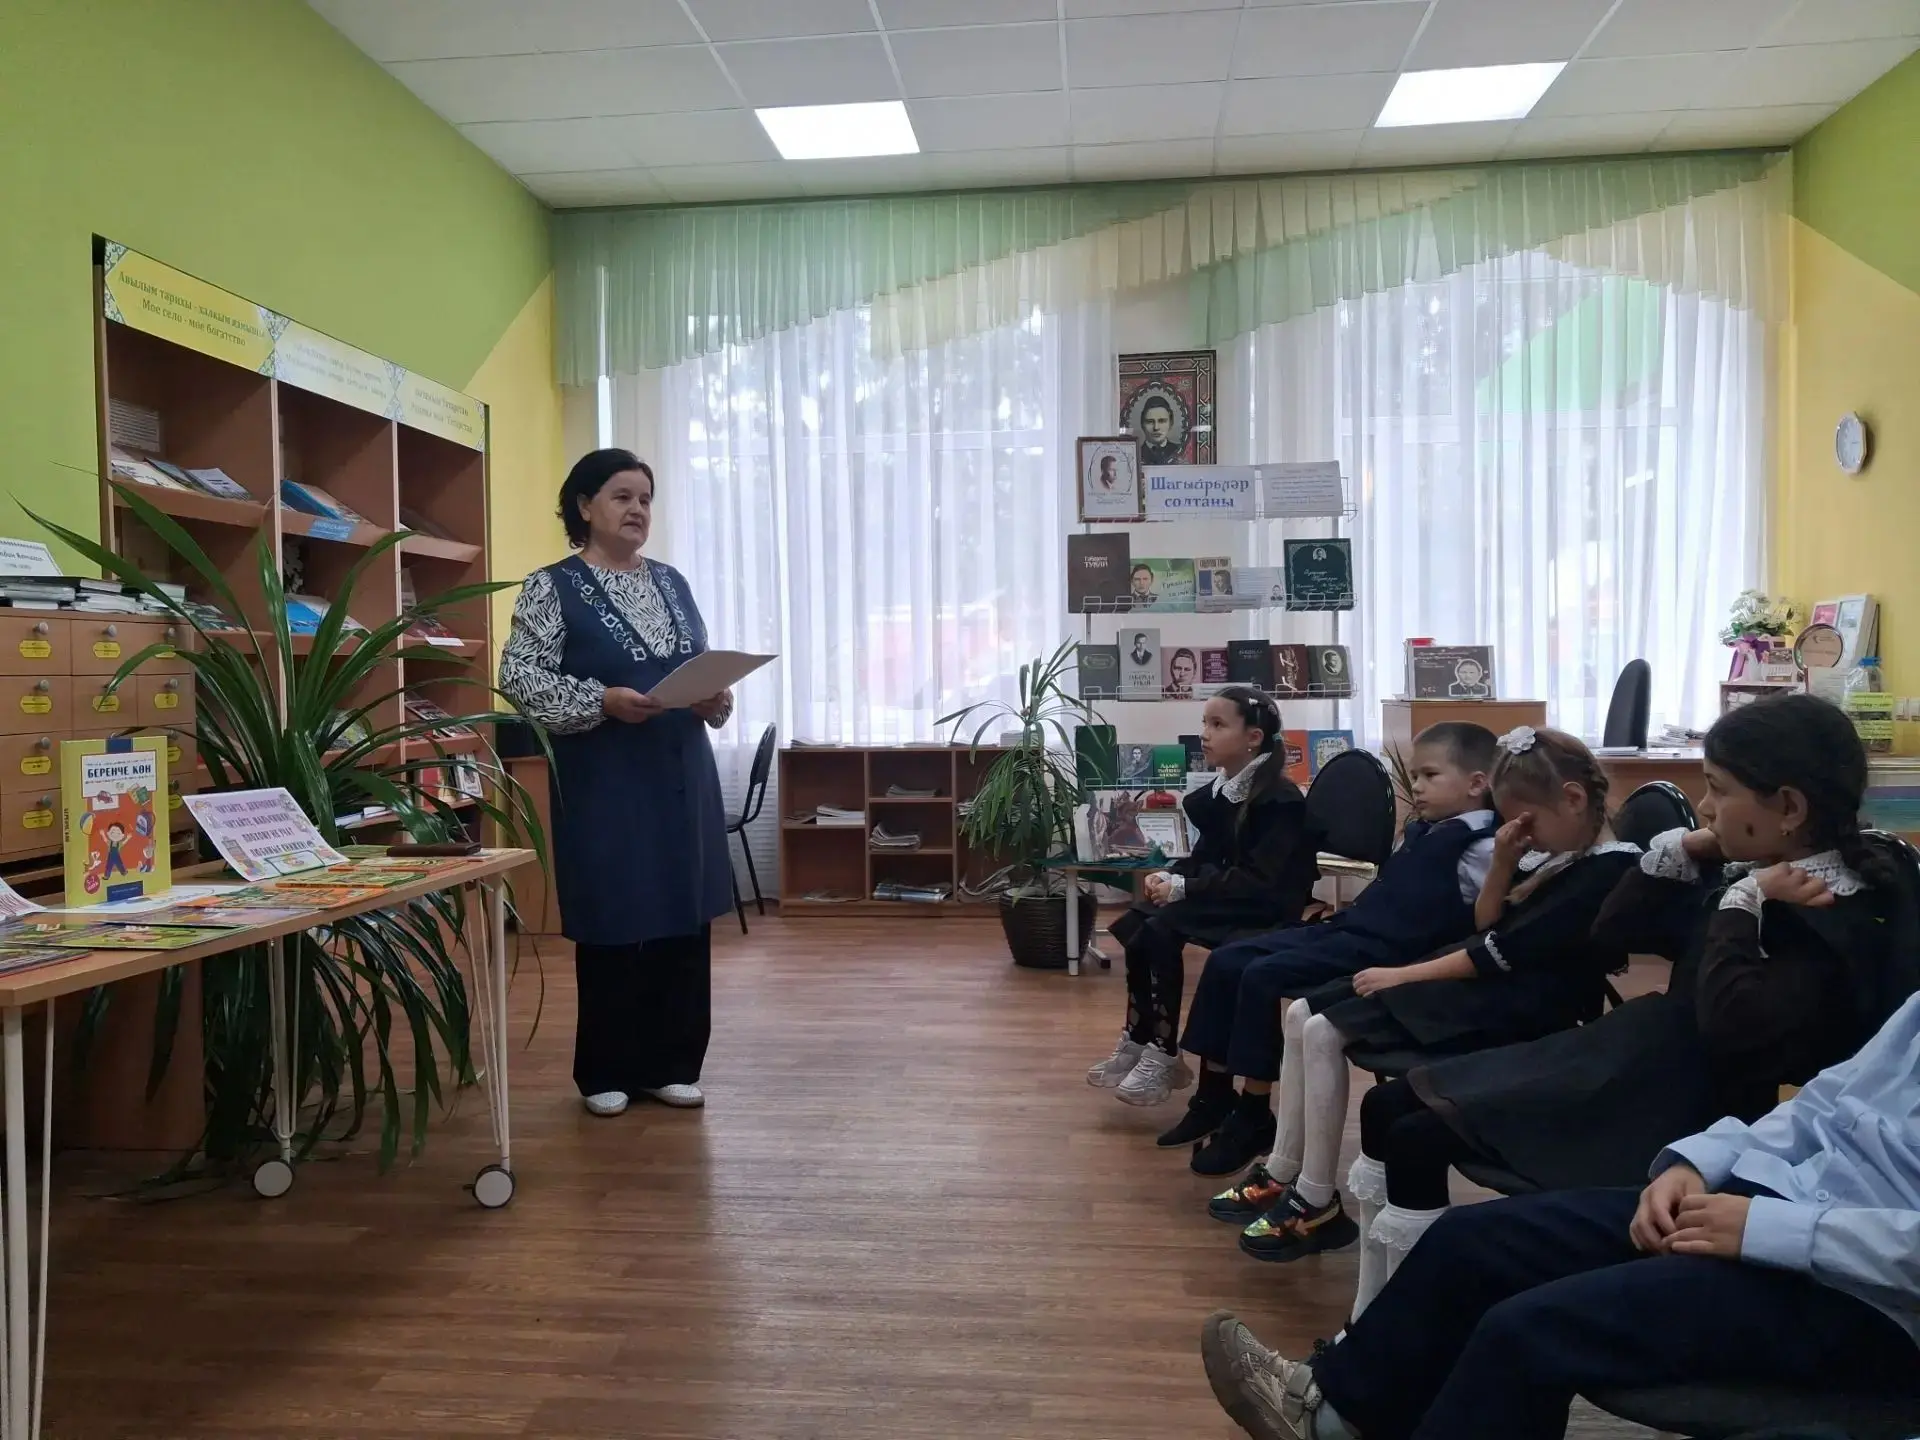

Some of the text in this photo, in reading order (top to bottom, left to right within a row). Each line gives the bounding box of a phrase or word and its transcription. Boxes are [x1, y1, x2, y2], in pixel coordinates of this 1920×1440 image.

[118, 271, 158, 297] Авылым
[159, 289, 193, 310] тарихы
[142, 298, 161, 315] Мое
[162, 307, 182, 322] село
[188, 318, 205, 331] мое
[206, 322, 246, 347] богатство
[1164, 497, 1235, 508] солтаны
[87, 765, 151, 778] БЕРЕНЧЕ КӨН
